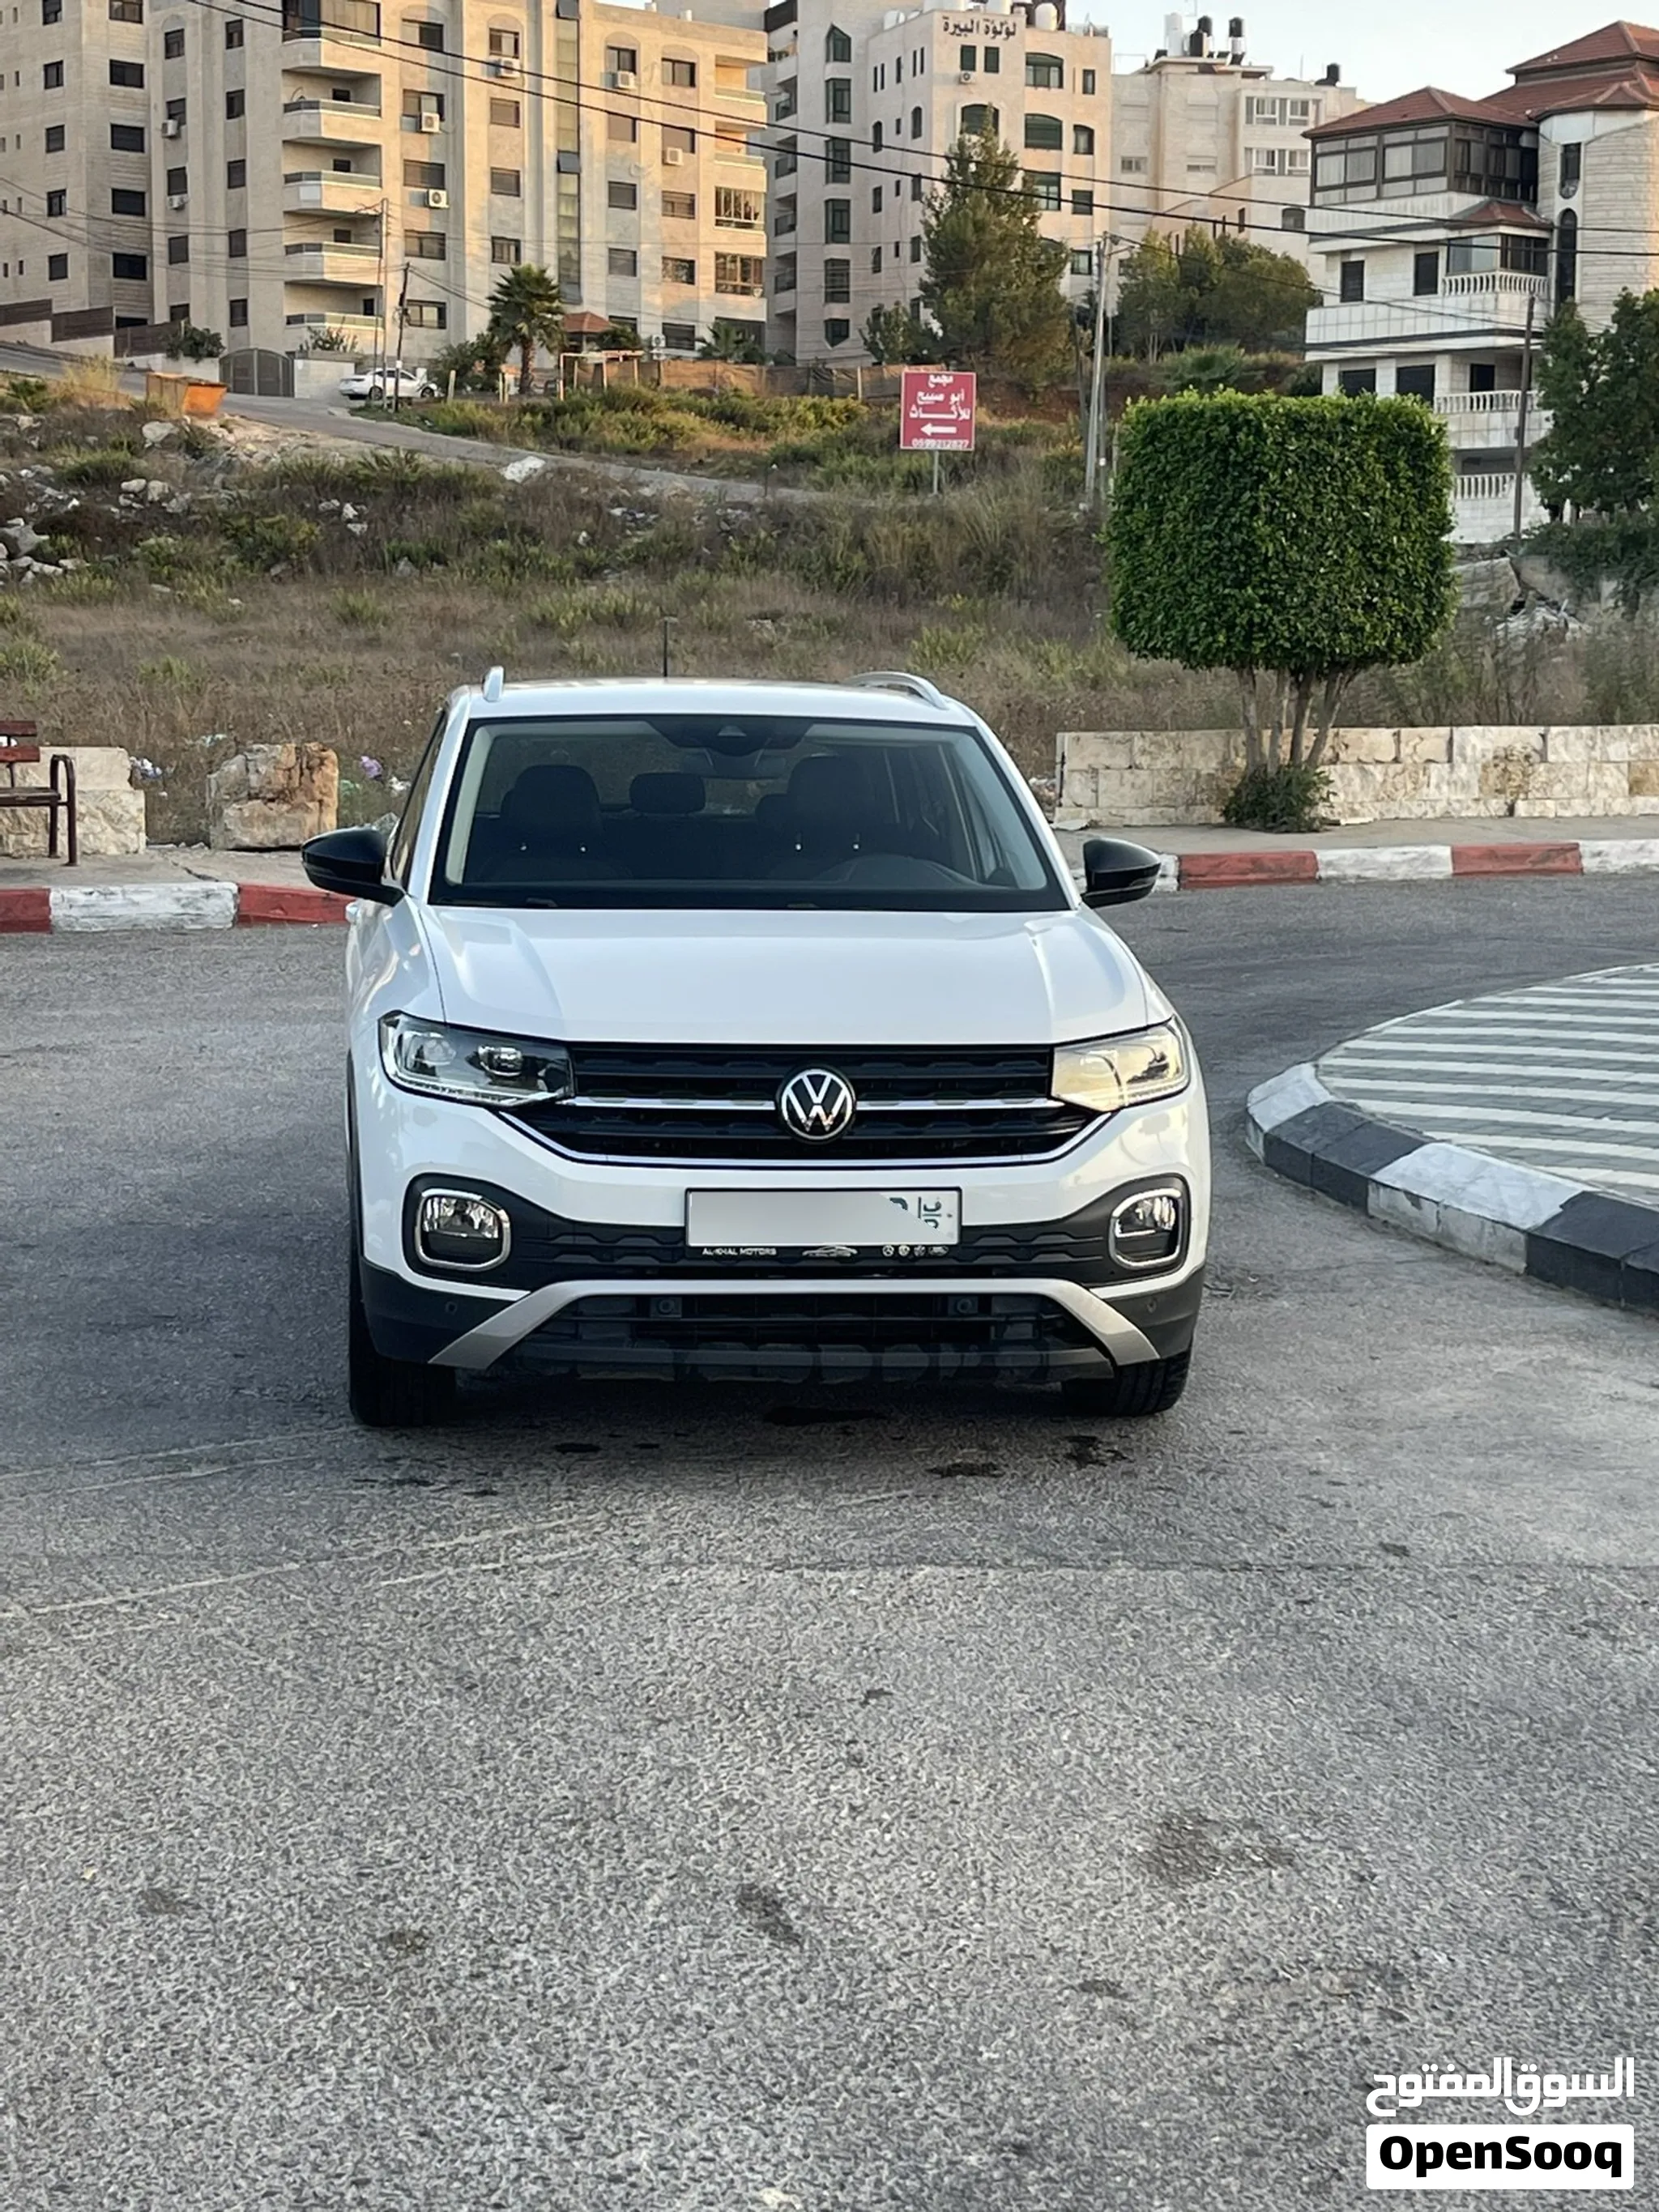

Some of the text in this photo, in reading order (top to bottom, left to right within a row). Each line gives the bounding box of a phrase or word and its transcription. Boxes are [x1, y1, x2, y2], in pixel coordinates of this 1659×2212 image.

[942, 15, 1017, 40] لؤلؤة البيرة
[928, 374, 953, 388] مجمع
[740, 1247, 777, 1255] MOTORS
